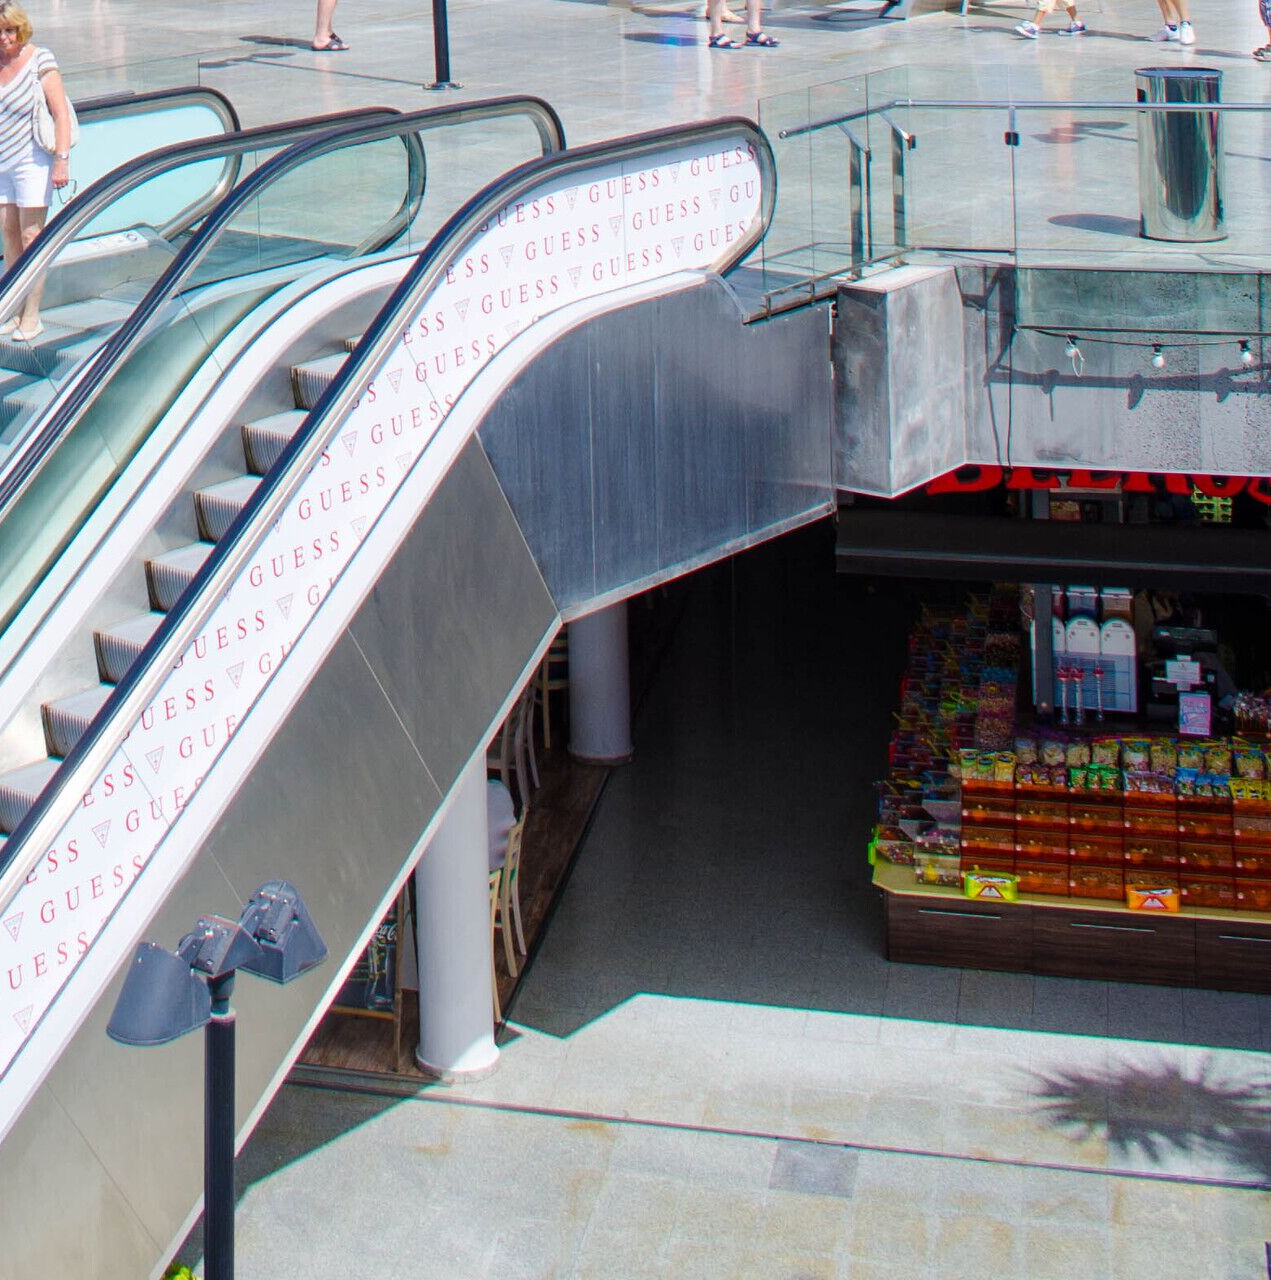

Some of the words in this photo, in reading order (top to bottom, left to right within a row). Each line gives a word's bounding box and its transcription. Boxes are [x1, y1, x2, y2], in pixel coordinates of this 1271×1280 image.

[588, 168, 660, 204] GUESS
[689, 143, 756, 177] GUESS
[445, 253, 489, 286] ESS
[525, 224, 600, 261] GUESS
[632, 196, 701, 231] GUESS
[481, 275, 559, 315] GUESS
[592, 245, 663, 282] GUESS
[693, 220, 746, 252] GUES
[415, 334, 496, 383] GUESS
[370, 393, 455, 446] GUESS
[298, 466, 386, 521] GUESS
[249, 531, 340, 588] GUESS
[122, 679, 215, 742] UESS
[39, 854, 144, 925] GUESS
